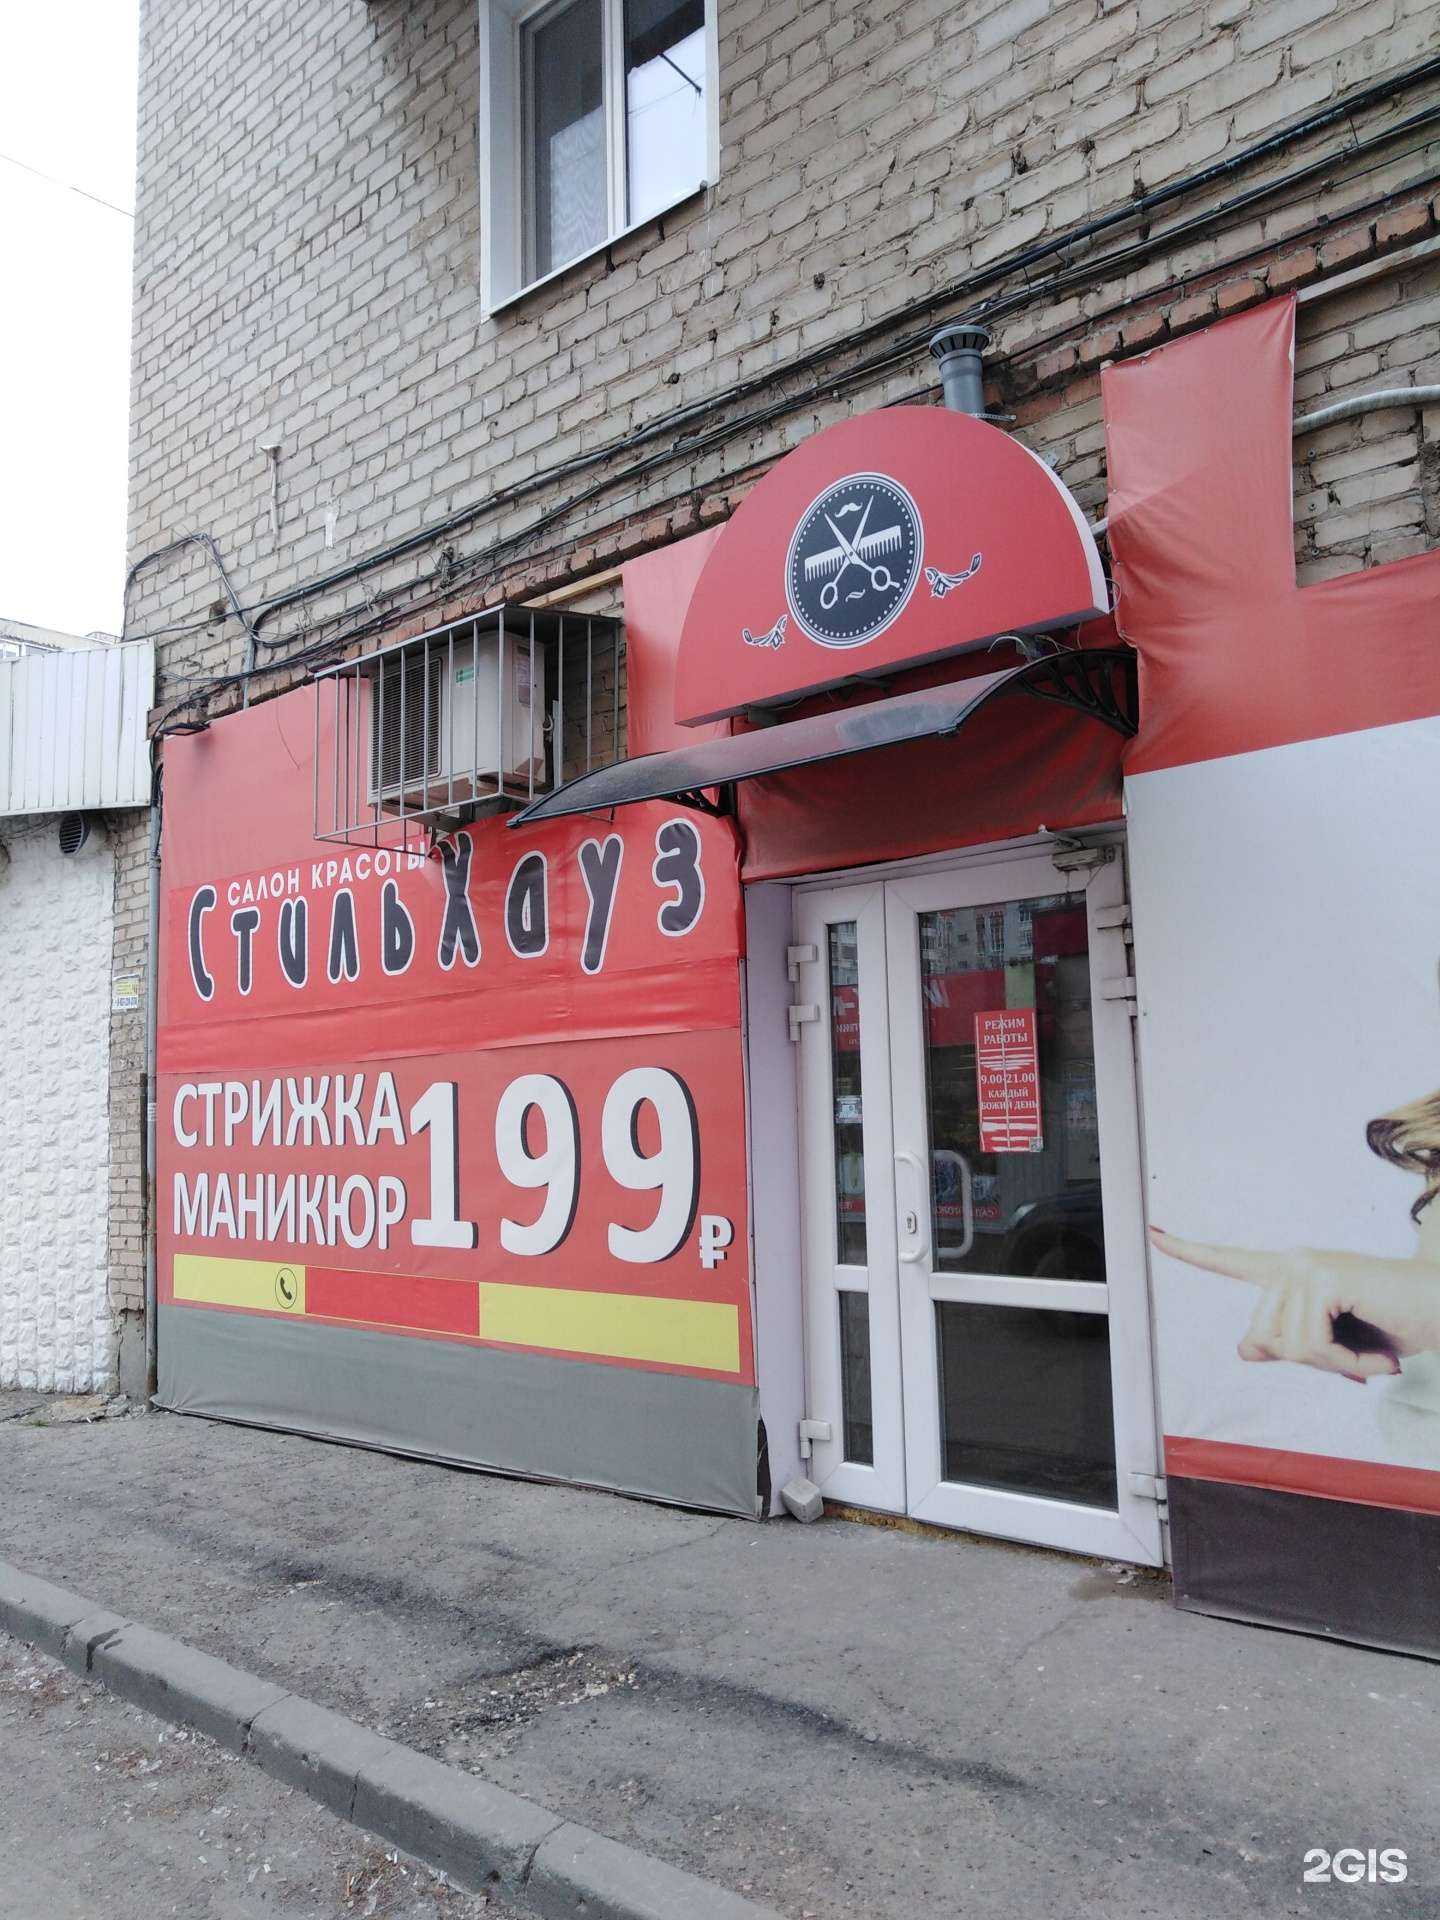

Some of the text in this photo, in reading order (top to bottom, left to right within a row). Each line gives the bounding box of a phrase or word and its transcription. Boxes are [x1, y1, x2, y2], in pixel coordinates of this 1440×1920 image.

[227, 841, 425, 906] САЛОН КРАСОТЫ
[983, 1032, 1028, 1045] РАБОТЫ
[984, 1018, 1025, 1030] РЕЖИМ
[173, 1071, 408, 1149] СТРИЖКА
[988, 1087, 1029, 1099] КАЖДЫЙ
[173, 1172, 408, 1251] МАНИКЮР
